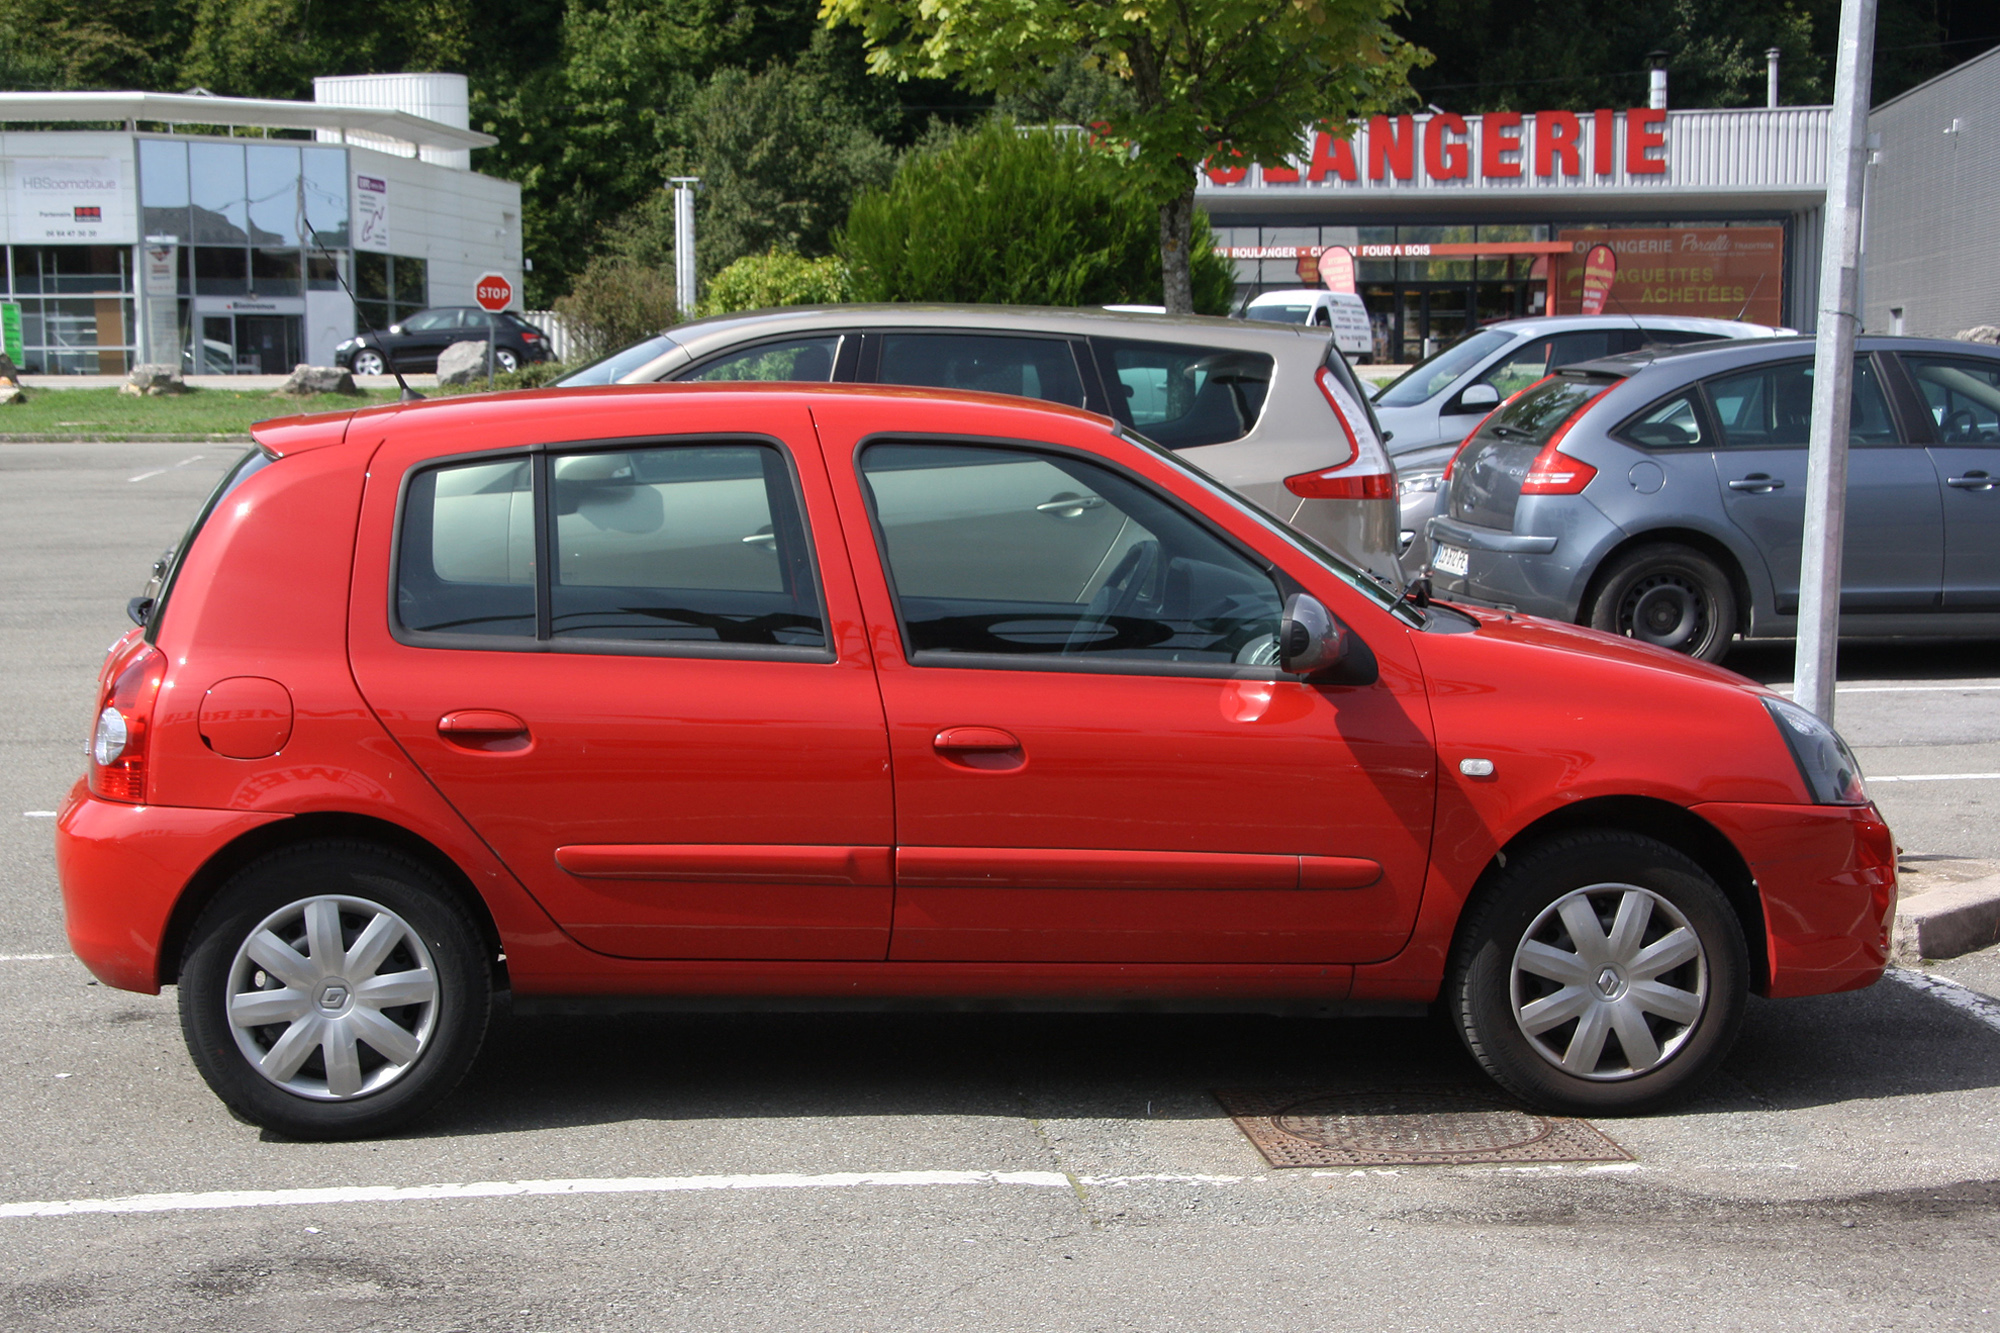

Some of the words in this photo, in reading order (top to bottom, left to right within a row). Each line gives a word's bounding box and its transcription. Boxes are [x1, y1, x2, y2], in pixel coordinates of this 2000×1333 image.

[1232, 246, 1297, 258] BOULANGER
[1362, 245, 1392, 257] FOUR
[1405, 244, 1430, 256] BOIS
[1734, 242, 1775, 250] TRADITION
[479, 287, 509, 299] STOP
[1641, 284, 1745, 303] ACHETÉES
